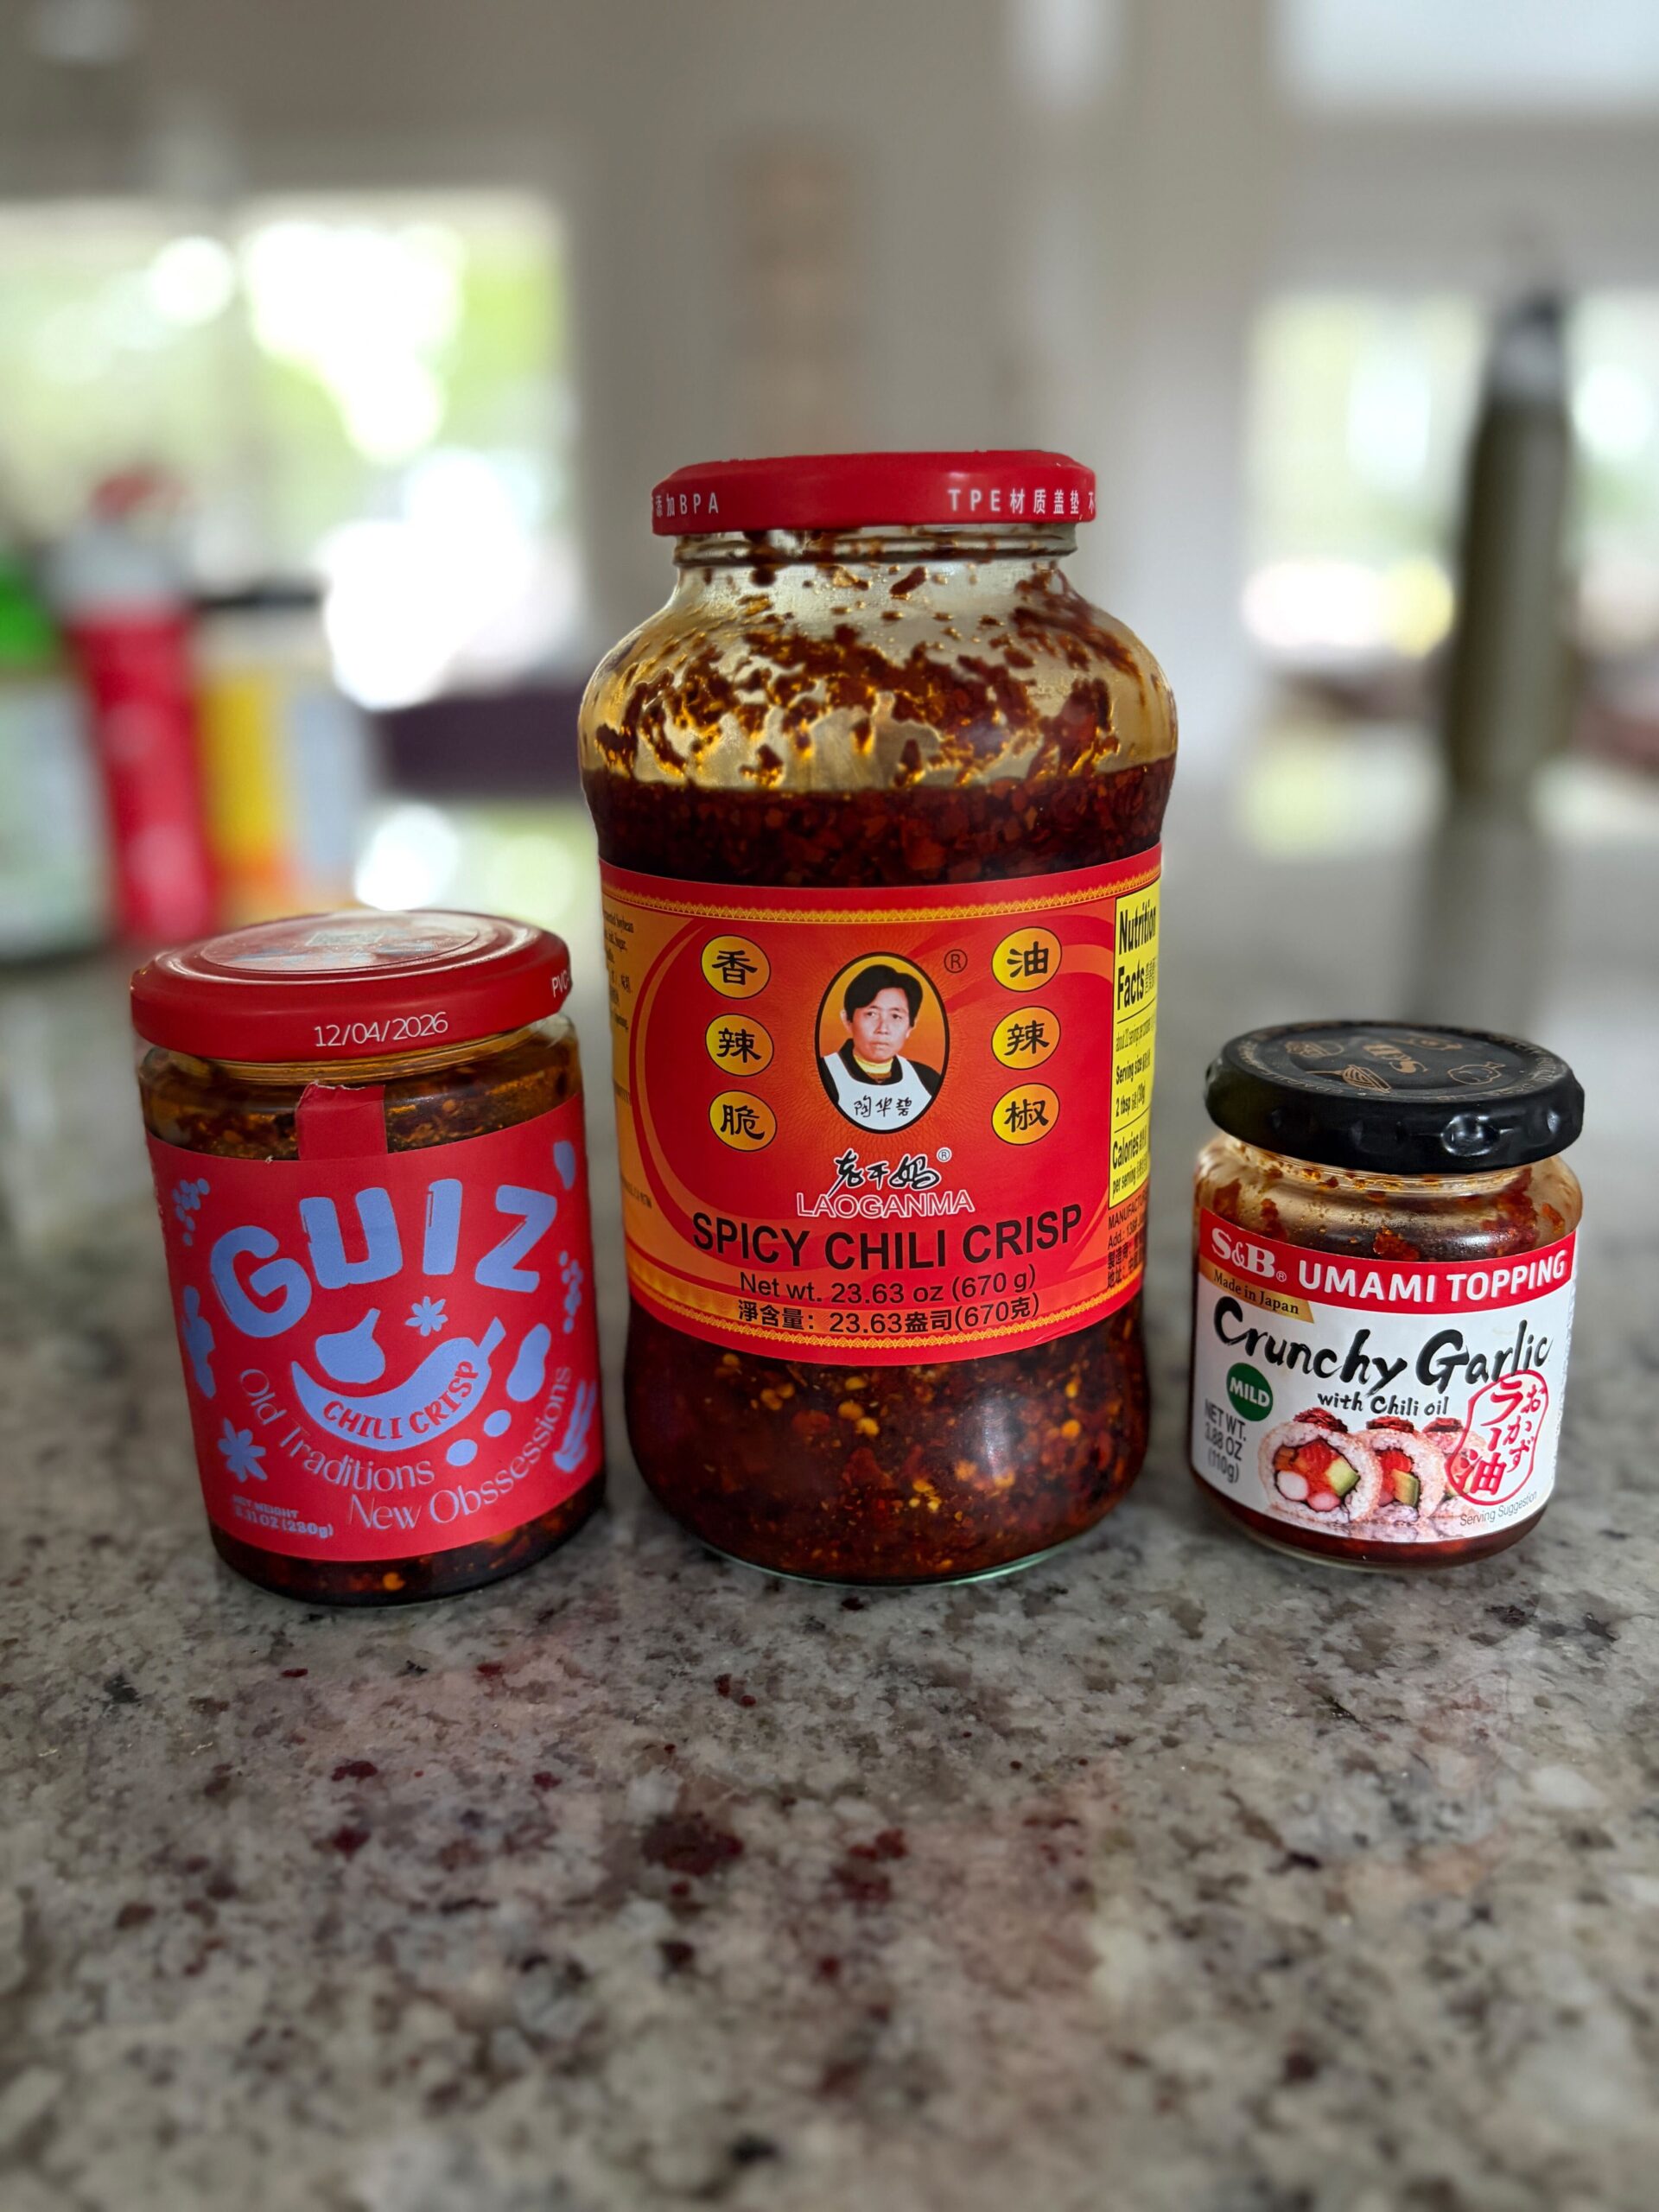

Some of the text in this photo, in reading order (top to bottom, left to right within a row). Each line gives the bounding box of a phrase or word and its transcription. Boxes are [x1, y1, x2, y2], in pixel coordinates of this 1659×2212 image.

[1118, 899, 1157, 956] Nutrition
[1116, 959, 1145, 1011] Facts
[314, 1011, 448, 1048] 12/04/2026
[1112, 1131, 1139, 1170] Calories
[796, 1189, 976, 1219] LAOGANMA
[209, 1179, 558, 1338] GUIZ
[692, 1211, 810, 1267] SPICY
[824, 1230, 945, 1271] CHILI
[962, 1204, 1082, 1264] CRISP
[740, 1263, 1036, 1305] Net wt. 23.63 oz (670 g)
[1213, 1268, 1300, 1314] Made in Japan
[1298, 1260, 1435, 1303] UMAMI
[1446, 1250, 1567, 1303] TOPPING
[1213, 1296, 1554, 1399] Crunchy Garlic
[322, 1360, 480, 1440] CHILI CRISP
[1229, 1376, 1270, 1408] MILD
[1317, 1392, 1449, 1417] with Chili oil
[239, 1368, 435, 1492] Old Traditions
[1205, 1398, 1247, 1442] NET WT.
[1456, 1380, 1525, 1496] ラー油
[1502, 1383, 1547, 1473] おかず
[349, 1366, 572, 1530] New Obssessions
[1207, 1446, 1240, 1484] (110g)
[1225, 1436, 1243, 1462] OZ
[254, 1502, 299, 1519] WEIGHT
[259, 1514, 280, 1529] OZ
[1459, 1490, 1538, 1528] Serving Suggestion
